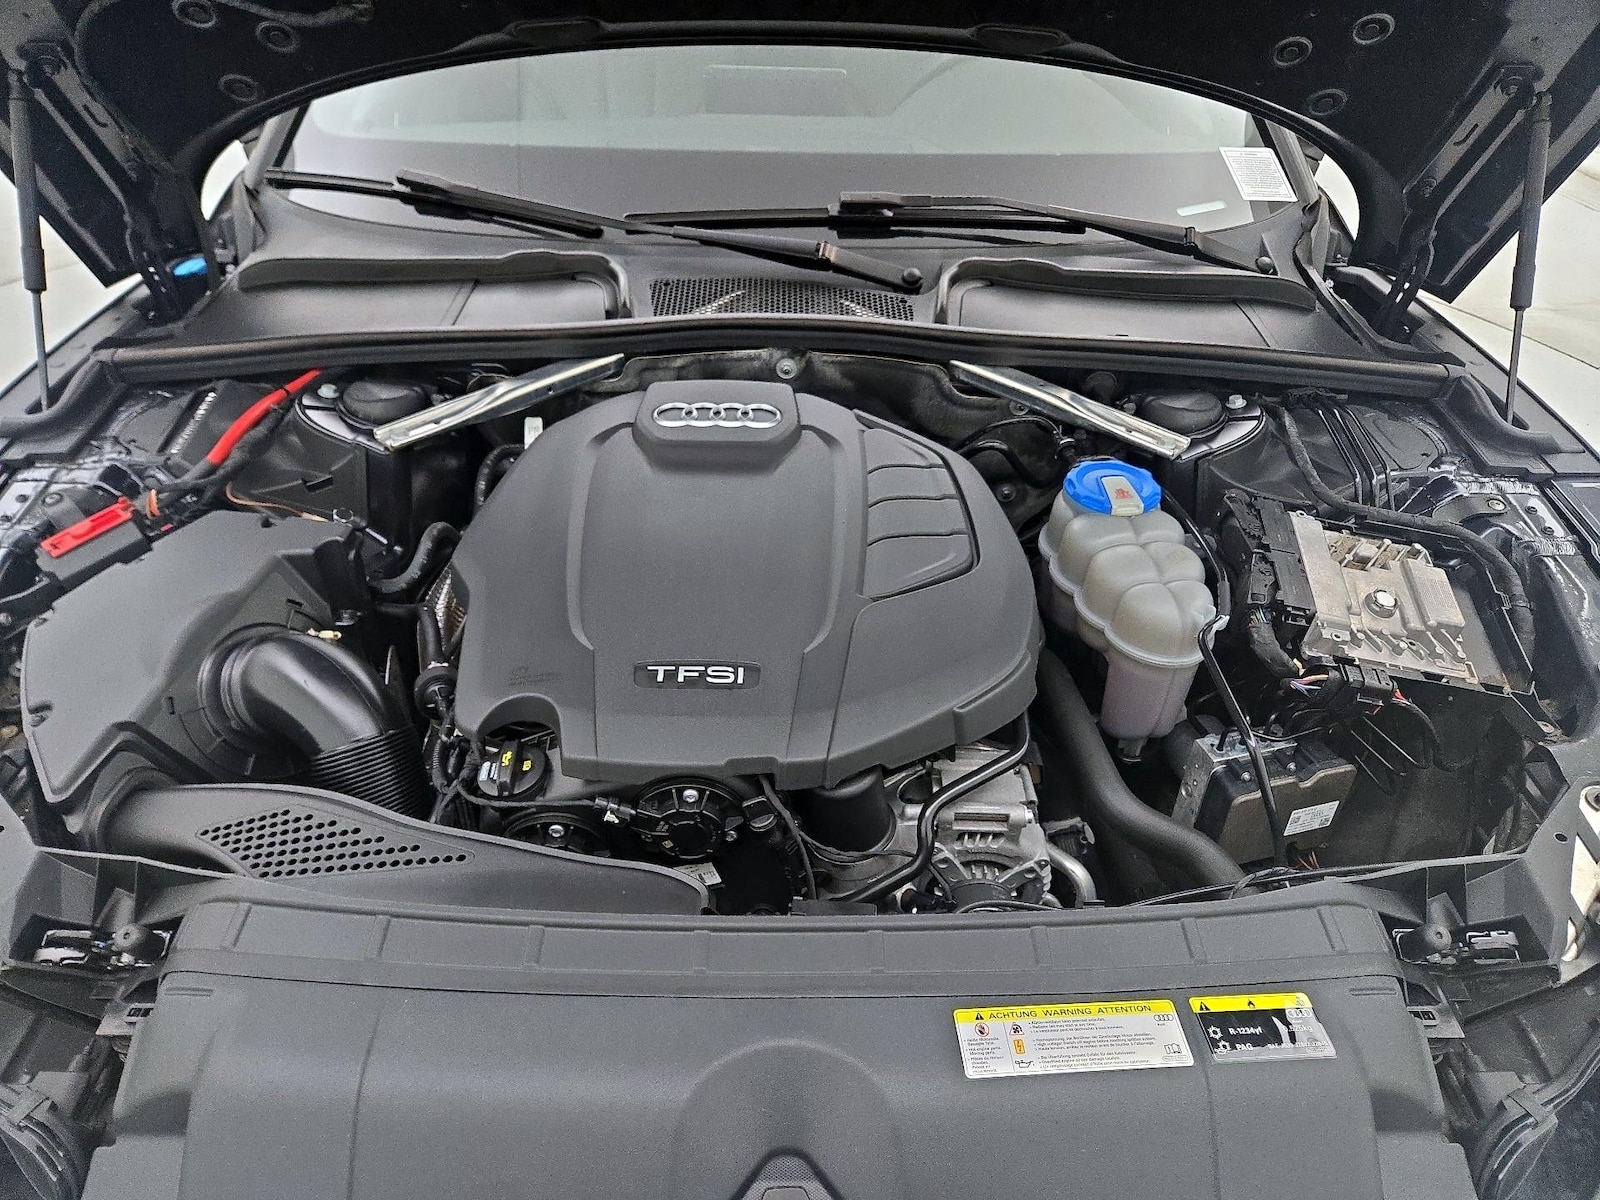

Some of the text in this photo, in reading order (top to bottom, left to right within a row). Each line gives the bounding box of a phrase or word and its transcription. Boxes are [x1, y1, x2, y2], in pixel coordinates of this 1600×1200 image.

[647, 666, 745, 684] TFSI
[988, 1005, 1152, 1020] ACHTUNG WARNING ATTENTION
[1235, 1042, 1253, 1051] PAG
